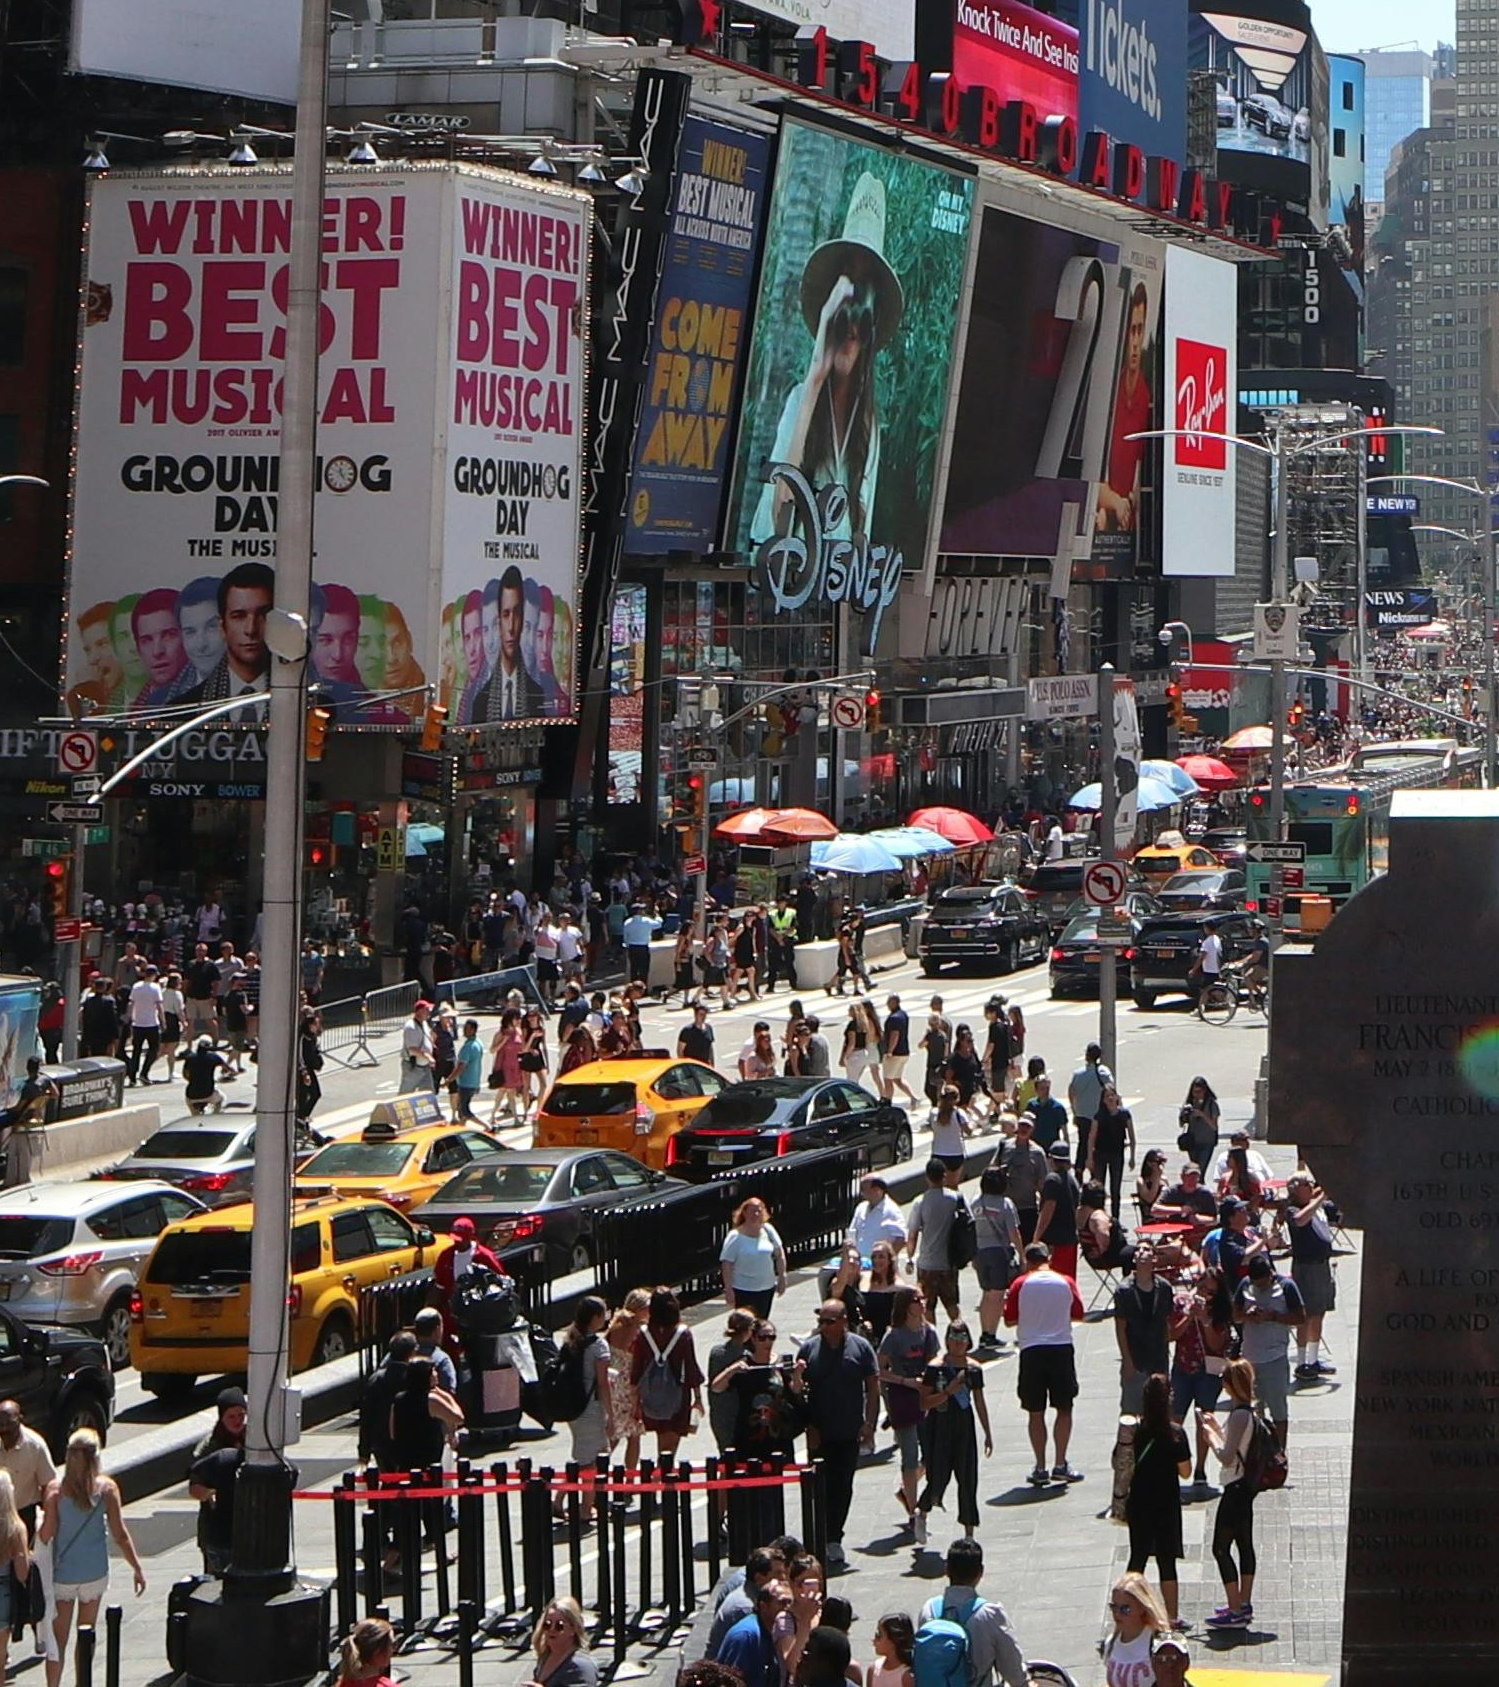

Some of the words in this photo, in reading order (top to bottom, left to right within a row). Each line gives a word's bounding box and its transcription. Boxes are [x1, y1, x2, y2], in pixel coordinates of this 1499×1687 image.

[992, 11, 1021, 49] Twice
[1021, 25, 1042, 58] And
[1044, 34, 1063, 66] See
[393, 115, 464, 129] LAMAR
[813, 25, 959, 132] 1540
[980, 86, 1232, 229] BROADWAY
[678, 173, 709, 216] BEST
[709, 181, 755, 229] MUSICAL
[931, 207, 965, 235] DISNEY
[461, 197, 580, 275] WINNER!
[1305, 250, 1319, 324] 1500
[122, 258, 400, 361] BEST
[456, 259, 576, 375] BEST
[661, 297, 742, 357] COME
[119, 368, 395, 425] MUSIAL
[454, 368, 574, 435] MUSICAL
[650, 351, 735, 412] FROM
[641, 411, 727, 470] AWAY
[454, 455, 570, 500] GROUNDHOG
[496, 500, 530, 537] DAY
[1378, 498, 1404, 509] NEW
[187, 539, 224, 557] THE
[484, 540, 500, 559] THE
[503, 540, 540, 561] MUSICAL
[25, 780, 67, 794] Nikon
[150, 784, 204, 796] SONY
[496, 771, 521, 784] SONY
[380, 830, 392, 867] ATM
[1262, 848, 1278, 857] ONE
[1282, 848, 1300, 858] WAY
[1374, 995, 1499, 1015] LIEUTENANT
[1358, 1023, 1482, 1051] FRANCIS
[1385, 1314, 1437, 1332] GOD
[1445, 1314, 1490, 1332] AND
